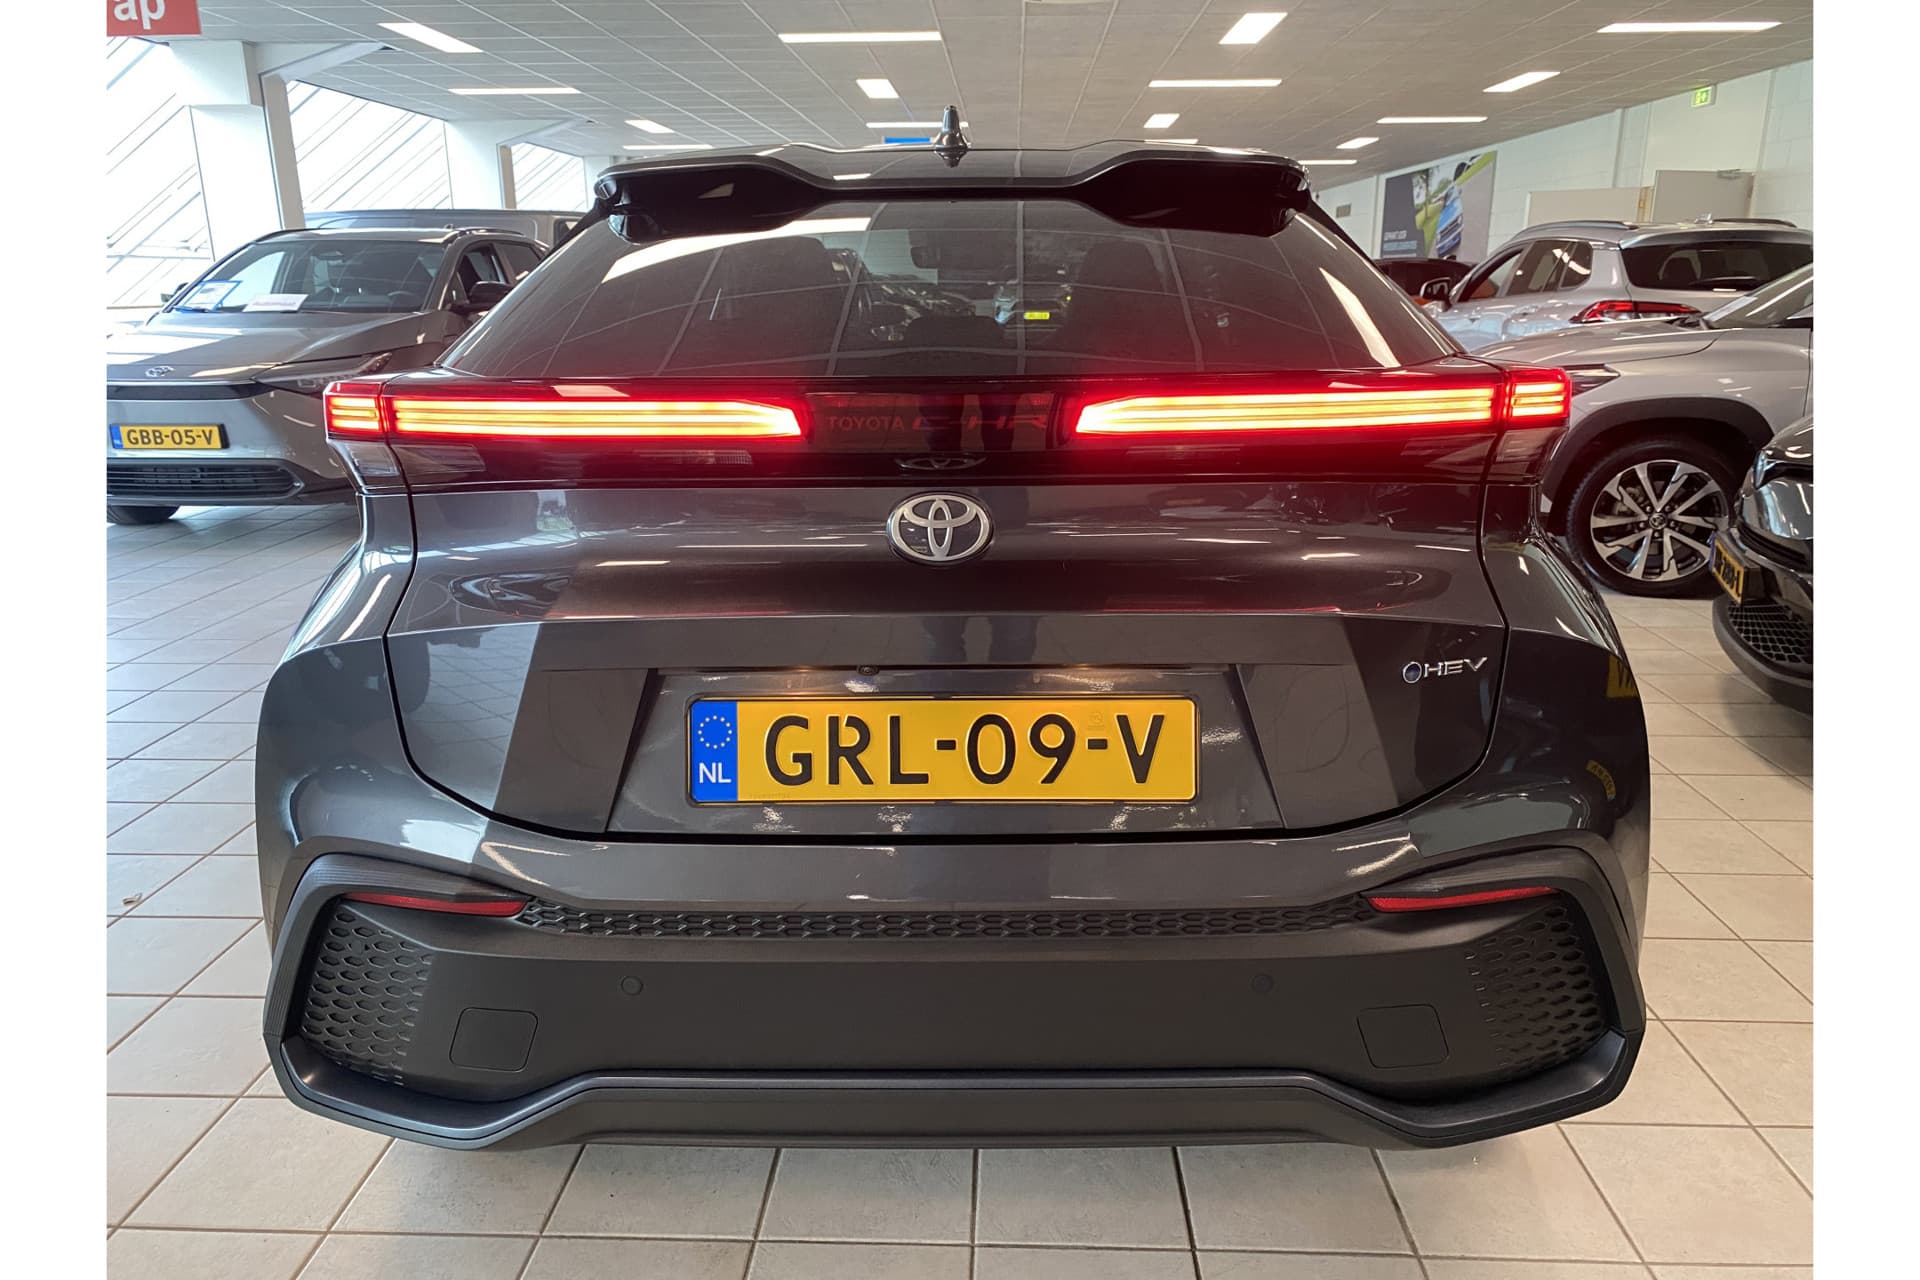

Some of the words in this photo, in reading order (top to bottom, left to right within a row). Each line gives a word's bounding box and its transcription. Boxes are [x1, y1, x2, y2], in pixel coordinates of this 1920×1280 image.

[829, 415, 905, 431] TOYOTA
[126, 429, 213, 446] GBB-05-V
[763, 713, 1166, 787] GRL-09-V
[698, 762, 732, 785] NL
